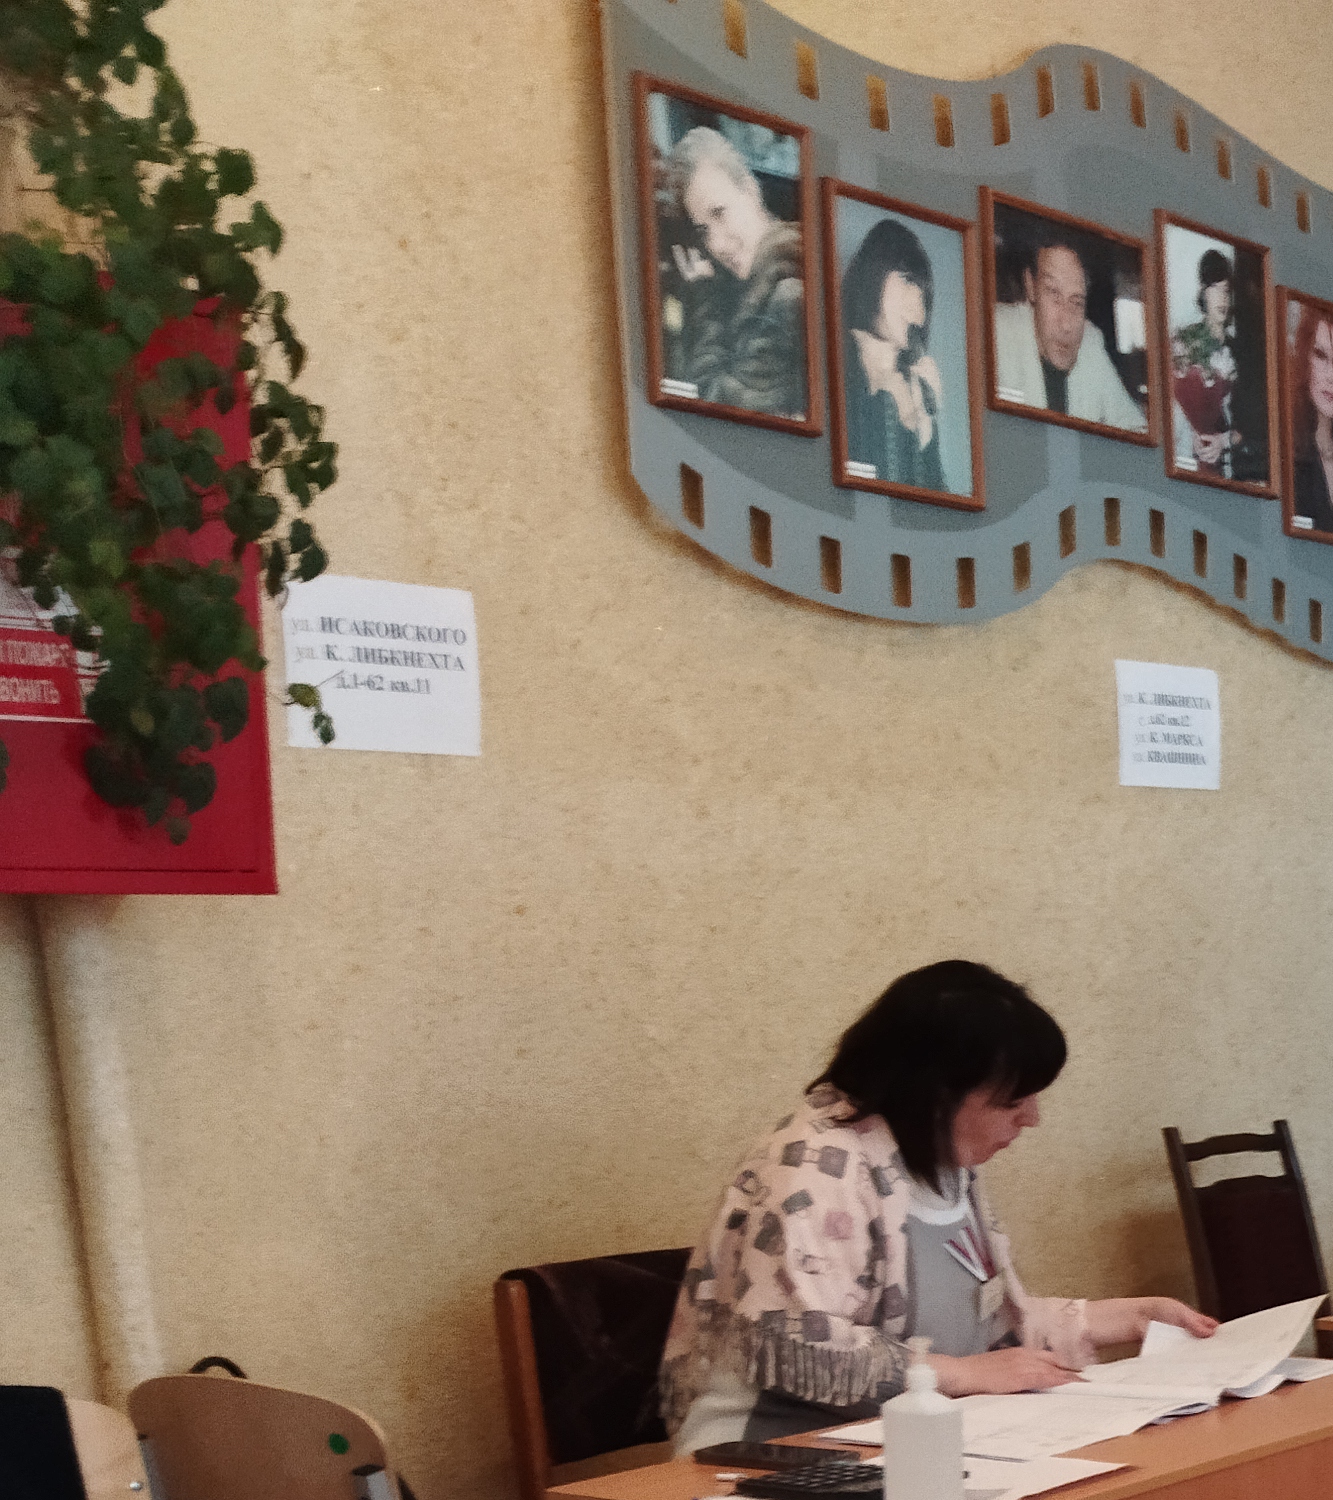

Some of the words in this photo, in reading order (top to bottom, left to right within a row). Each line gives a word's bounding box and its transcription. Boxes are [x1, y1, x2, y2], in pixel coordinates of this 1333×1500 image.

[320, 616, 467, 646] ИСАКОВСКОГО
[325, 643, 344, 662] К.
[348, 646, 466, 672] ЛИБКНЕХТА
